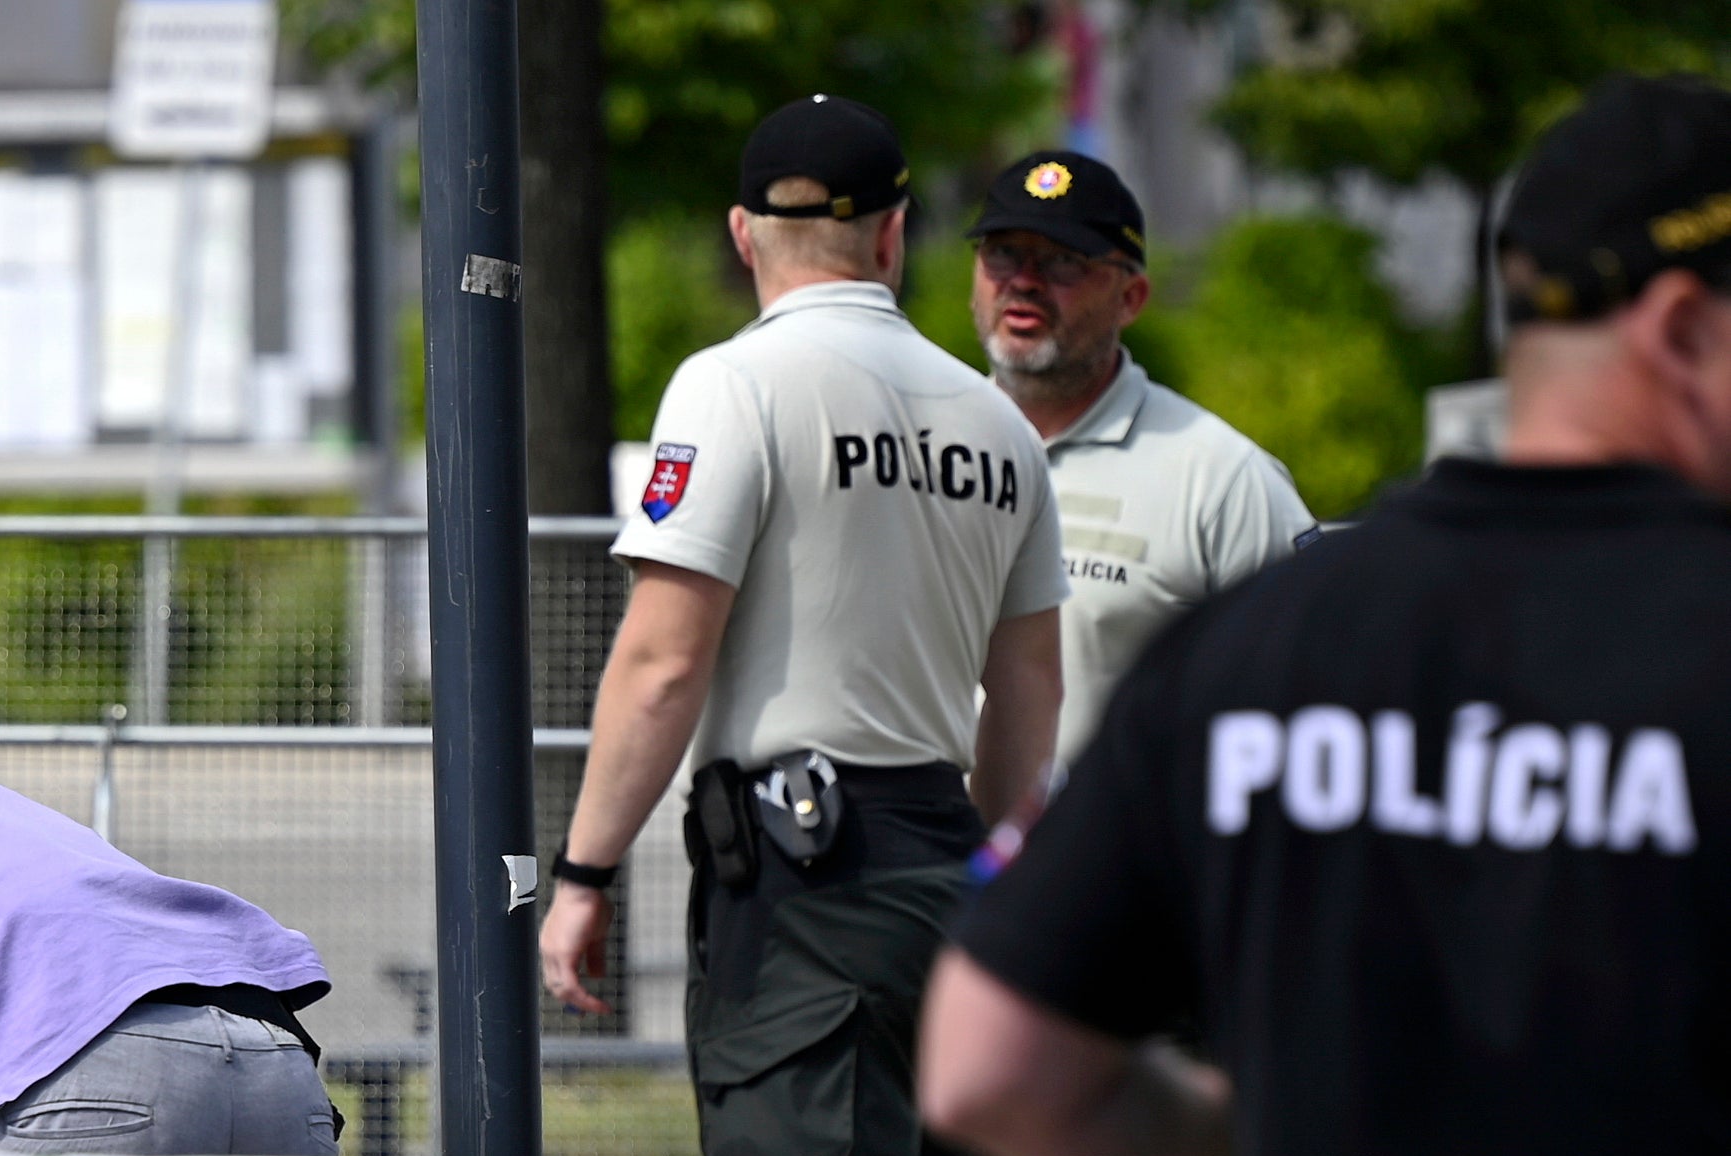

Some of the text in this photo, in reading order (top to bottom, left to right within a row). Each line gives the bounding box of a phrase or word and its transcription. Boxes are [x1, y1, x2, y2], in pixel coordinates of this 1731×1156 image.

[834, 428, 1018, 515] POLÍCIA
[1061, 557, 1127, 584] LÍCIA
[1206, 701, 1699, 856] POLÍCIA
